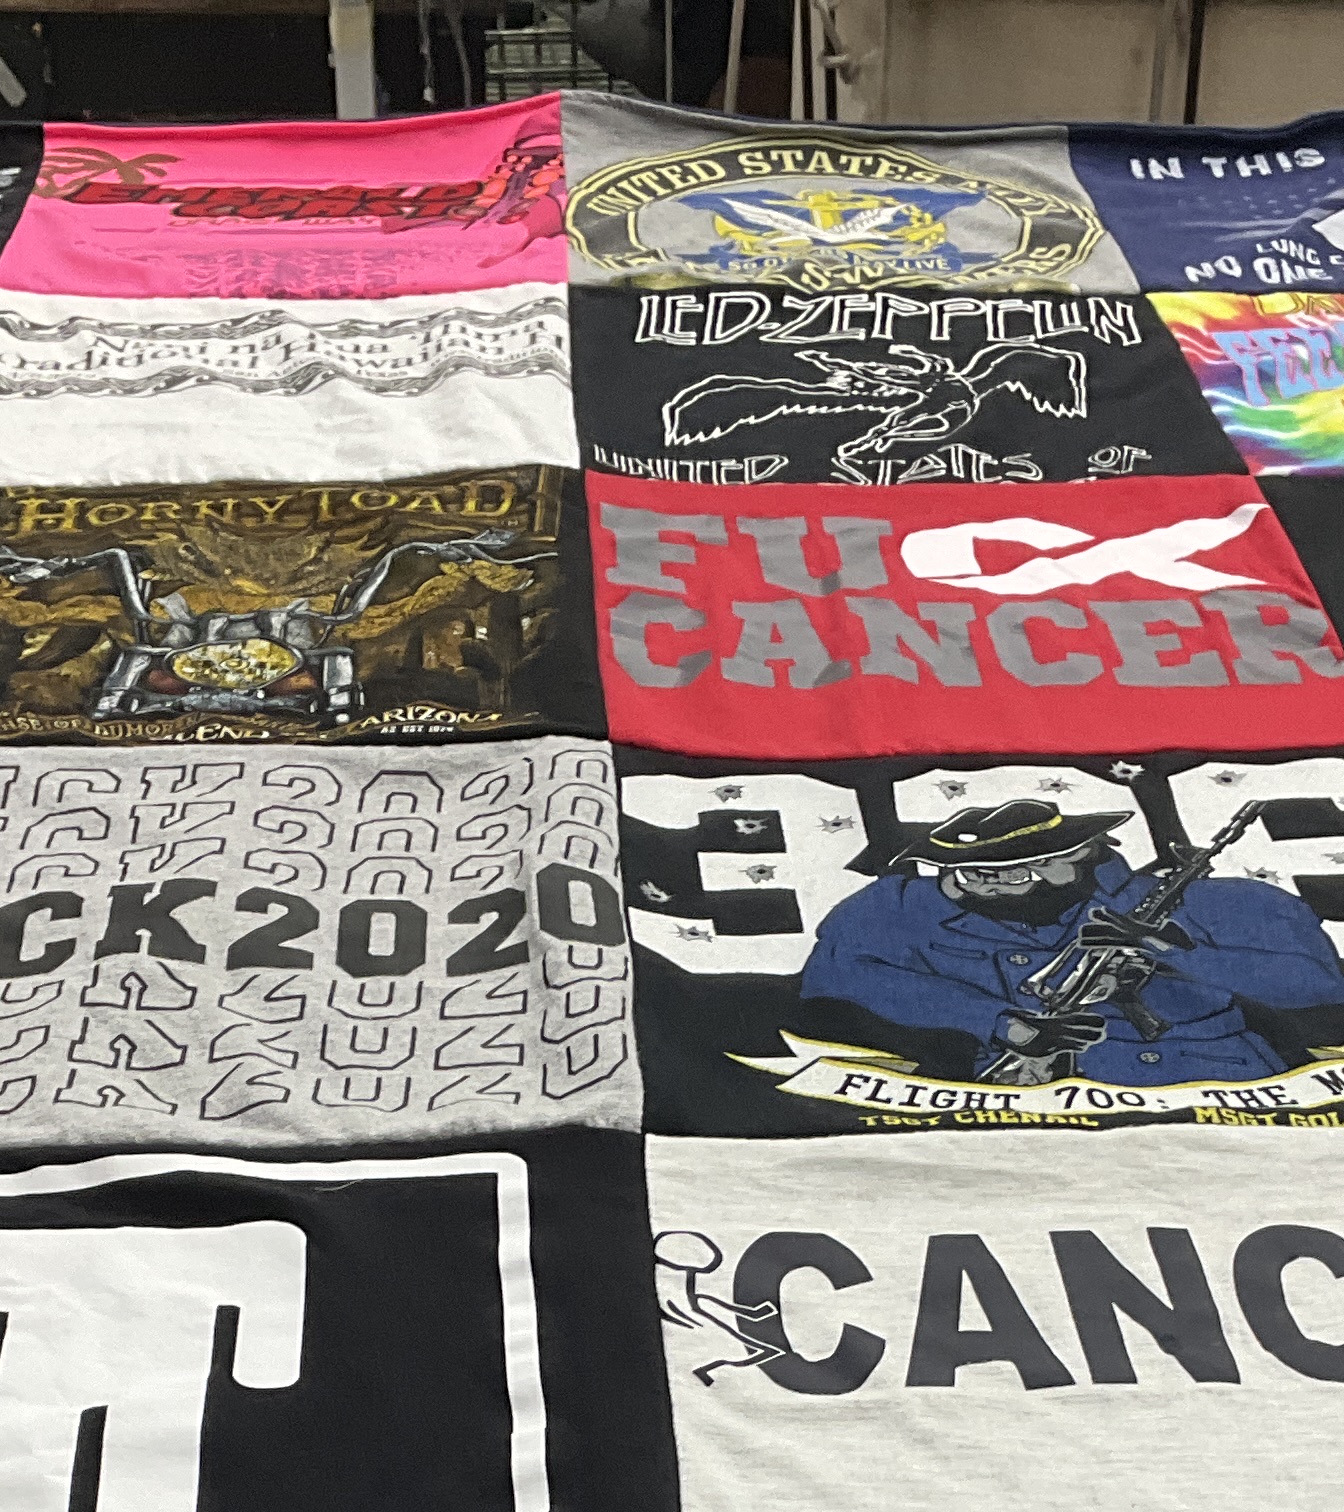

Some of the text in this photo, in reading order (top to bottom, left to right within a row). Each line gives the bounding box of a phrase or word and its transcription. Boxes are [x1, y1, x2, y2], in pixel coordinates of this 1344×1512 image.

[1129, 157, 1184, 180] IN
[1202, 147, 1326, 178] THIS
[585, 158, 728, 216] UNITED
[737, 150, 943, 184] STATES
[1256, 238, 1322, 266] LUNG
[1183, 256, 1243, 283] NO
[1255, 257, 1333, 285] ONE
[15, 479, 518, 534] HORNY TOAD
[359, 705, 504, 729] ARIZONA
[831, 1073, 1021, 1109] FLIGHT
[1204, 1085, 1299, 1109] THE
[1194, 1107, 1278, 1127] MSGT
